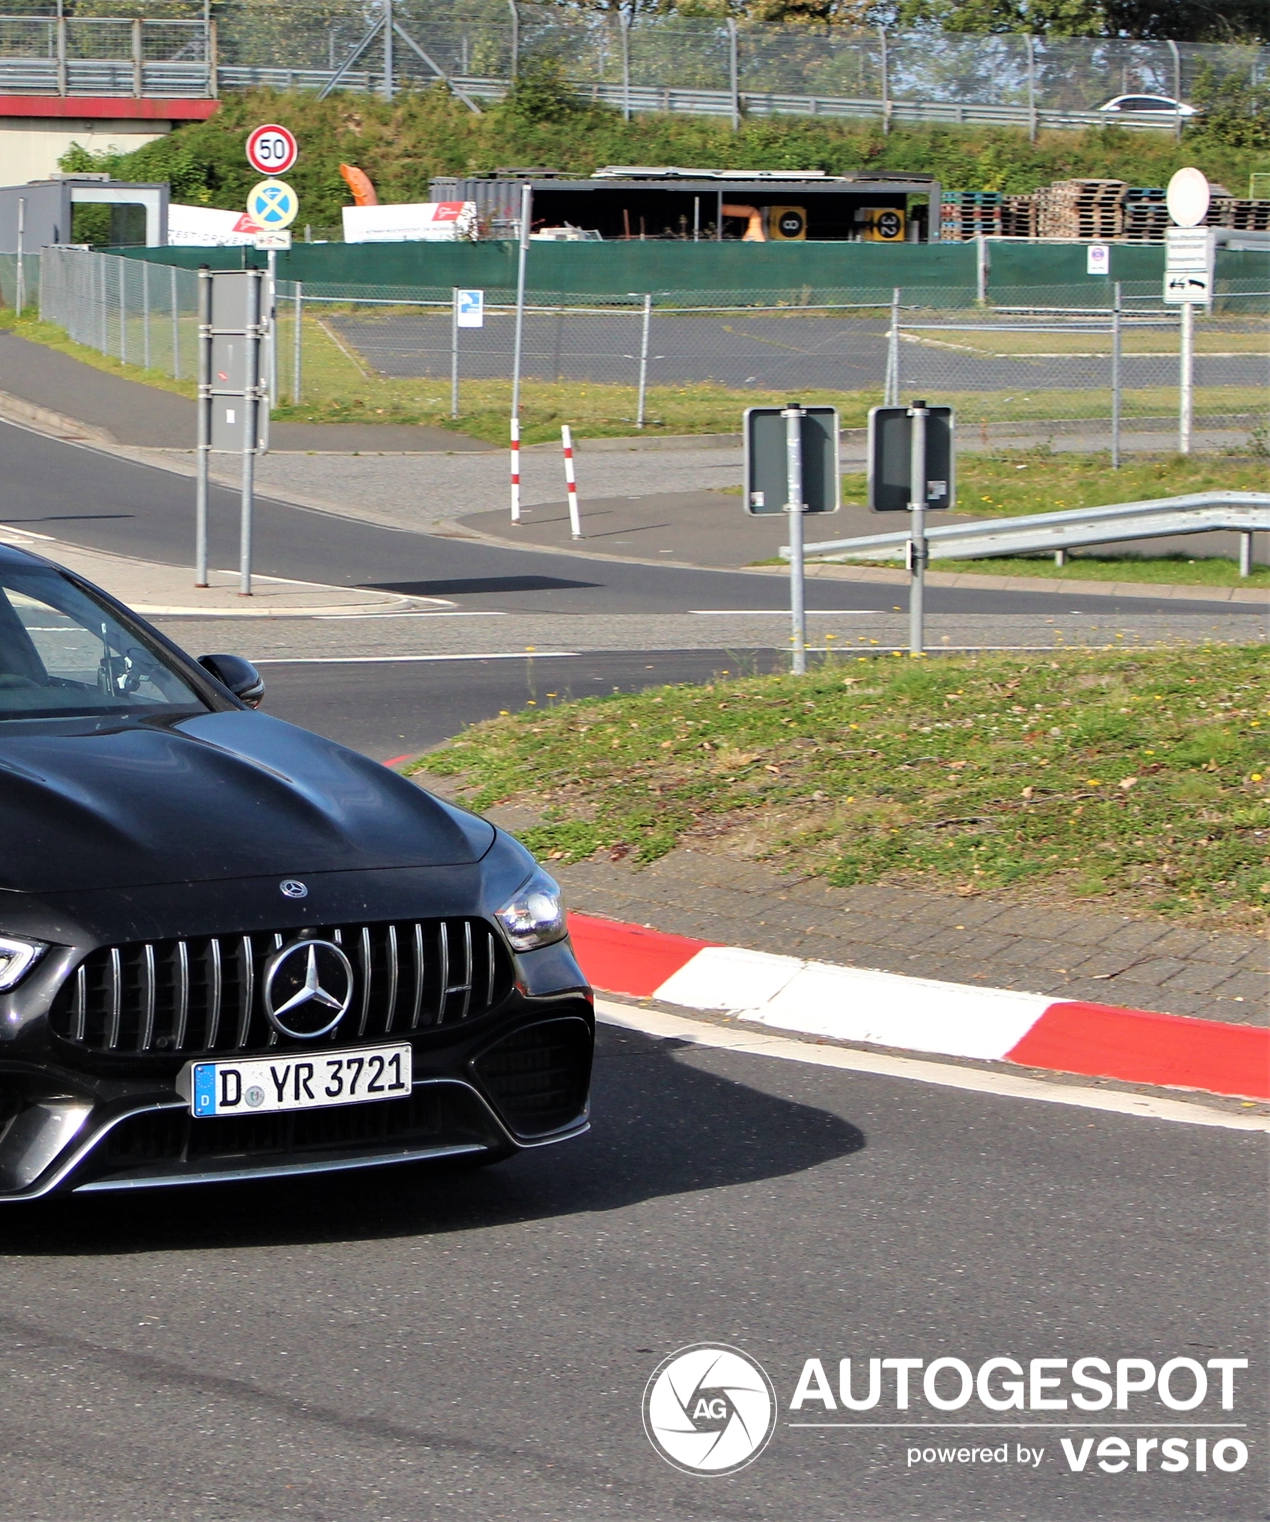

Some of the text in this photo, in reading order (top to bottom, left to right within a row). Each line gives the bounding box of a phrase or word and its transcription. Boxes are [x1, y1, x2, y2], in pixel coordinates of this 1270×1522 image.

[260, 139, 285, 159] 50
[783, 219, 800, 230] 8
[881, 216, 898, 235] 32
[219, 1053, 406, 1107] D YR 3721
[201, 1095, 210, 1106] D
